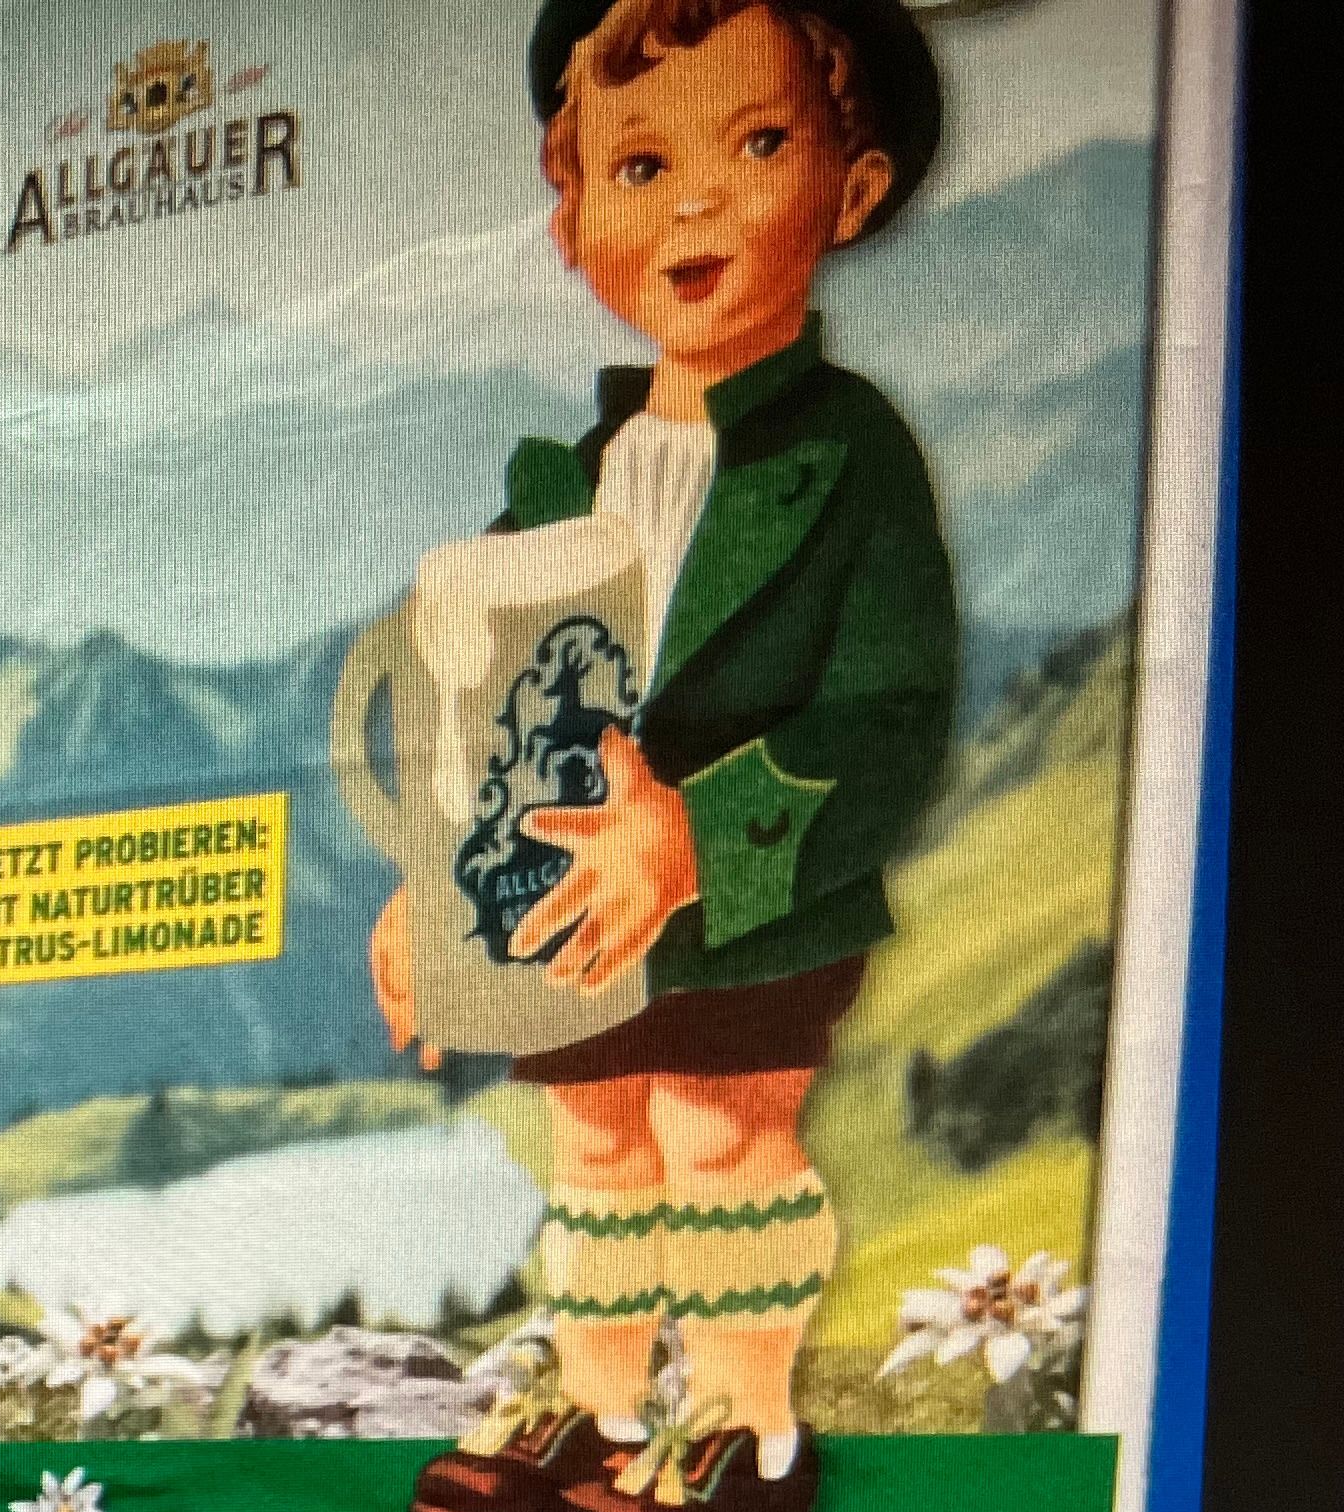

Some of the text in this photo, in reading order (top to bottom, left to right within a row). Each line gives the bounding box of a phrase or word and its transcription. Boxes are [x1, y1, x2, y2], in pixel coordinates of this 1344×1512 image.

[62, 174, 247, 240] BRAUHAUS
[75, 818, 269, 869] PROBIEREN:
[30, 866, 266, 923] NATURTRÜBER
